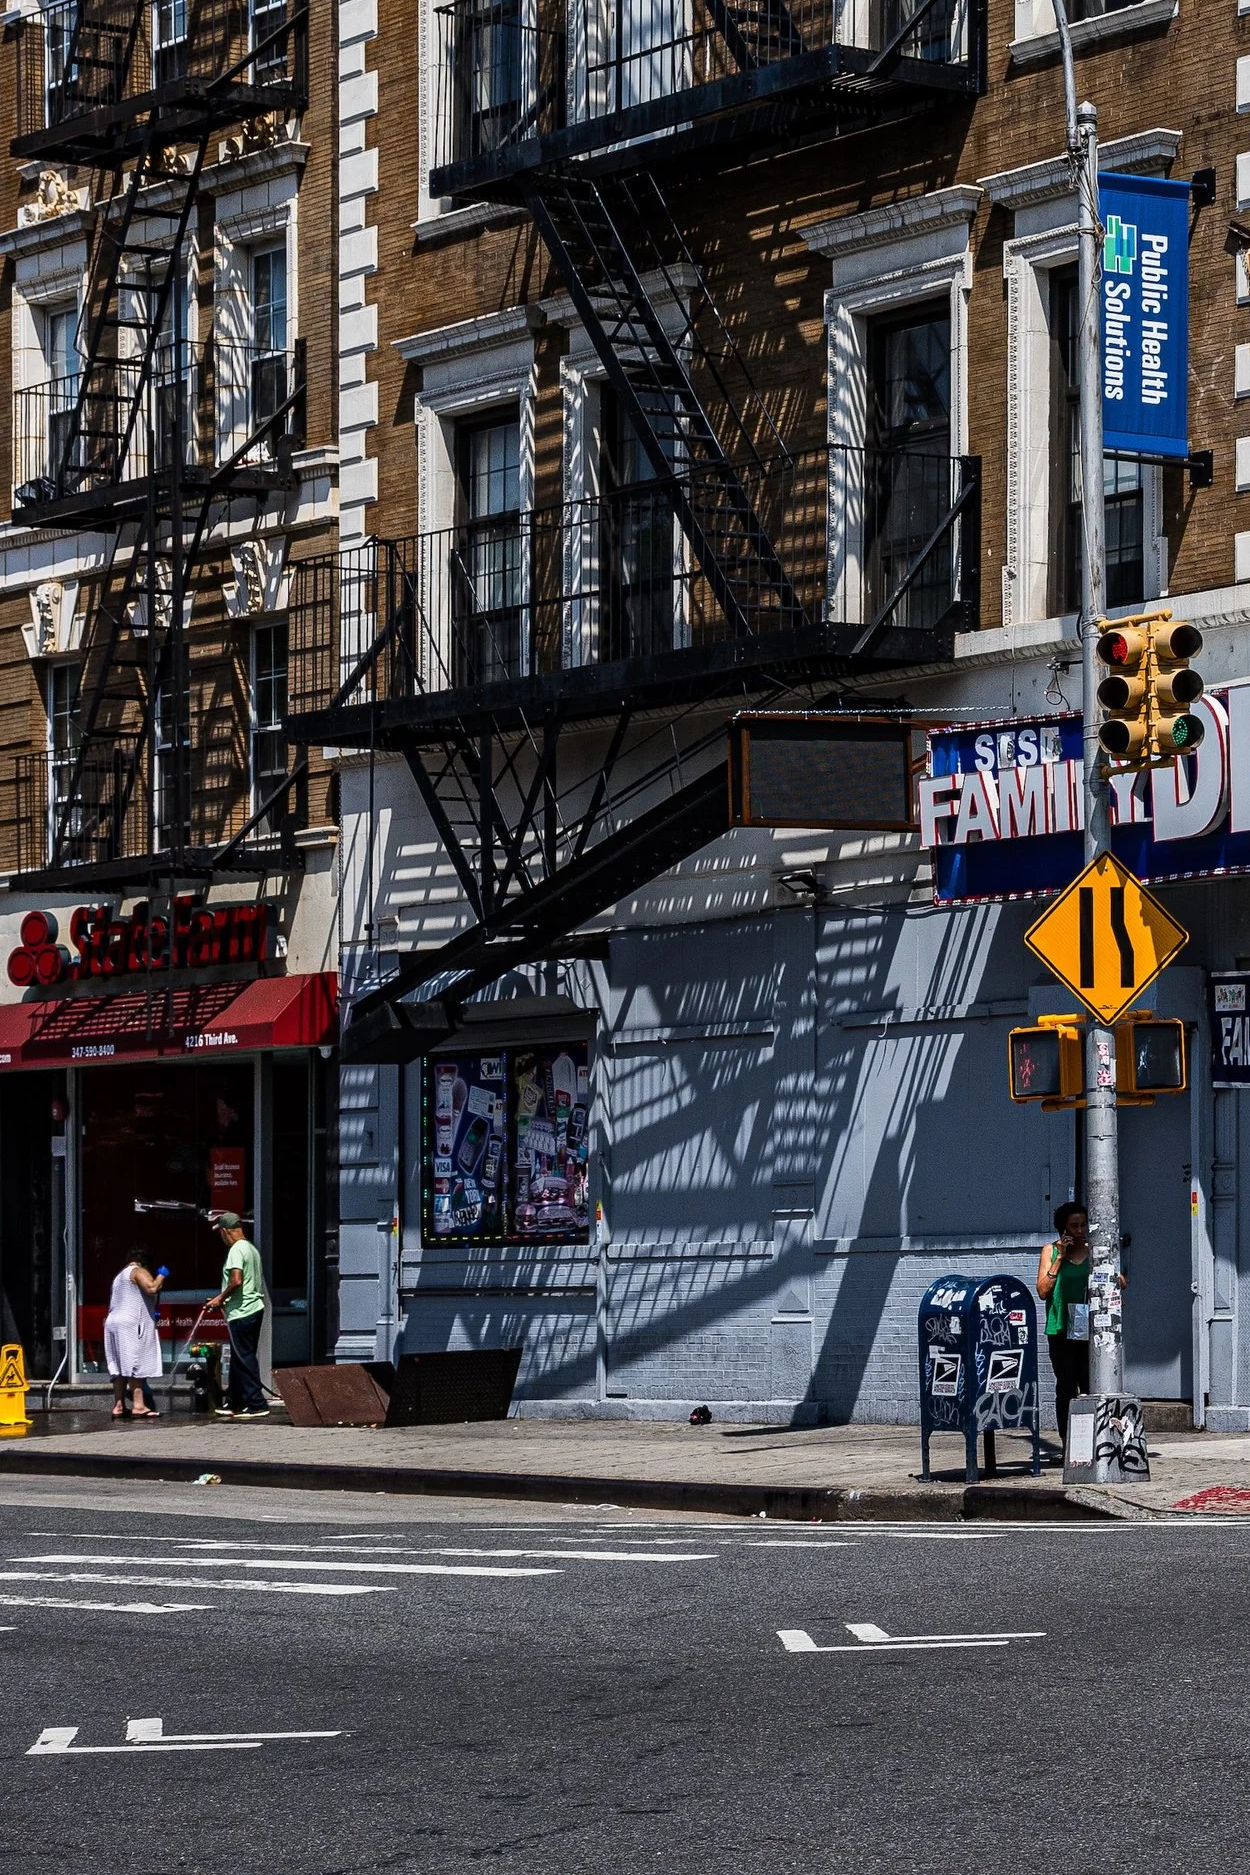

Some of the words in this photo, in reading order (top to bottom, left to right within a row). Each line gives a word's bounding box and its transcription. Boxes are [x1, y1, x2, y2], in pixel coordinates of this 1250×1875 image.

[1141, 233, 1168, 314] Public
[1104, 280, 1131, 401] Solutions
[1141, 319, 1168, 405] Health
[70, 902, 168, 981] State
[172, 894, 276, 968] Farm
[71, 1044, 115, 1058] 347-590-8400
[185, 1035, 204, 1048] 4216
[204, 1032, 222, 1046] Third
[223, 1032, 238, 1045] Ave.
